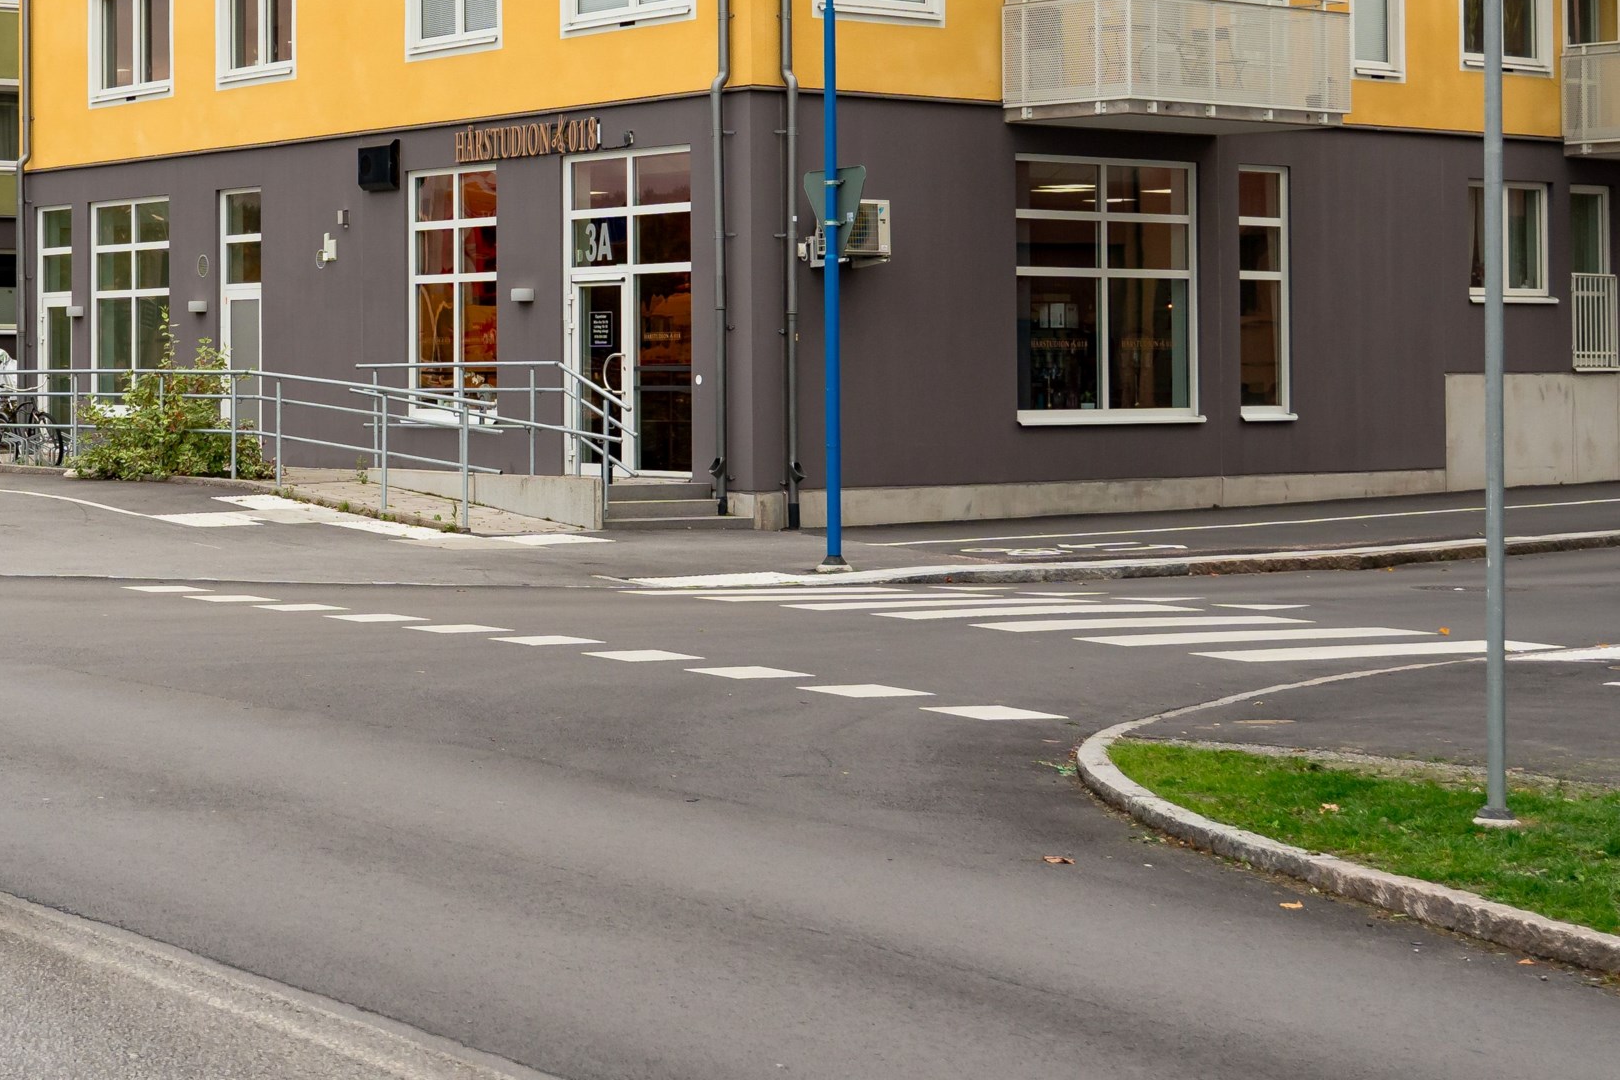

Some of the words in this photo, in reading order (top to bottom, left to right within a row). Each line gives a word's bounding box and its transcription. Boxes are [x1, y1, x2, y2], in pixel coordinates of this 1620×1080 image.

[455, 124, 552, 163] HÅRSTUDION
[568, 117, 598, 152] 018
[585, 223, 613, 262] 3A
